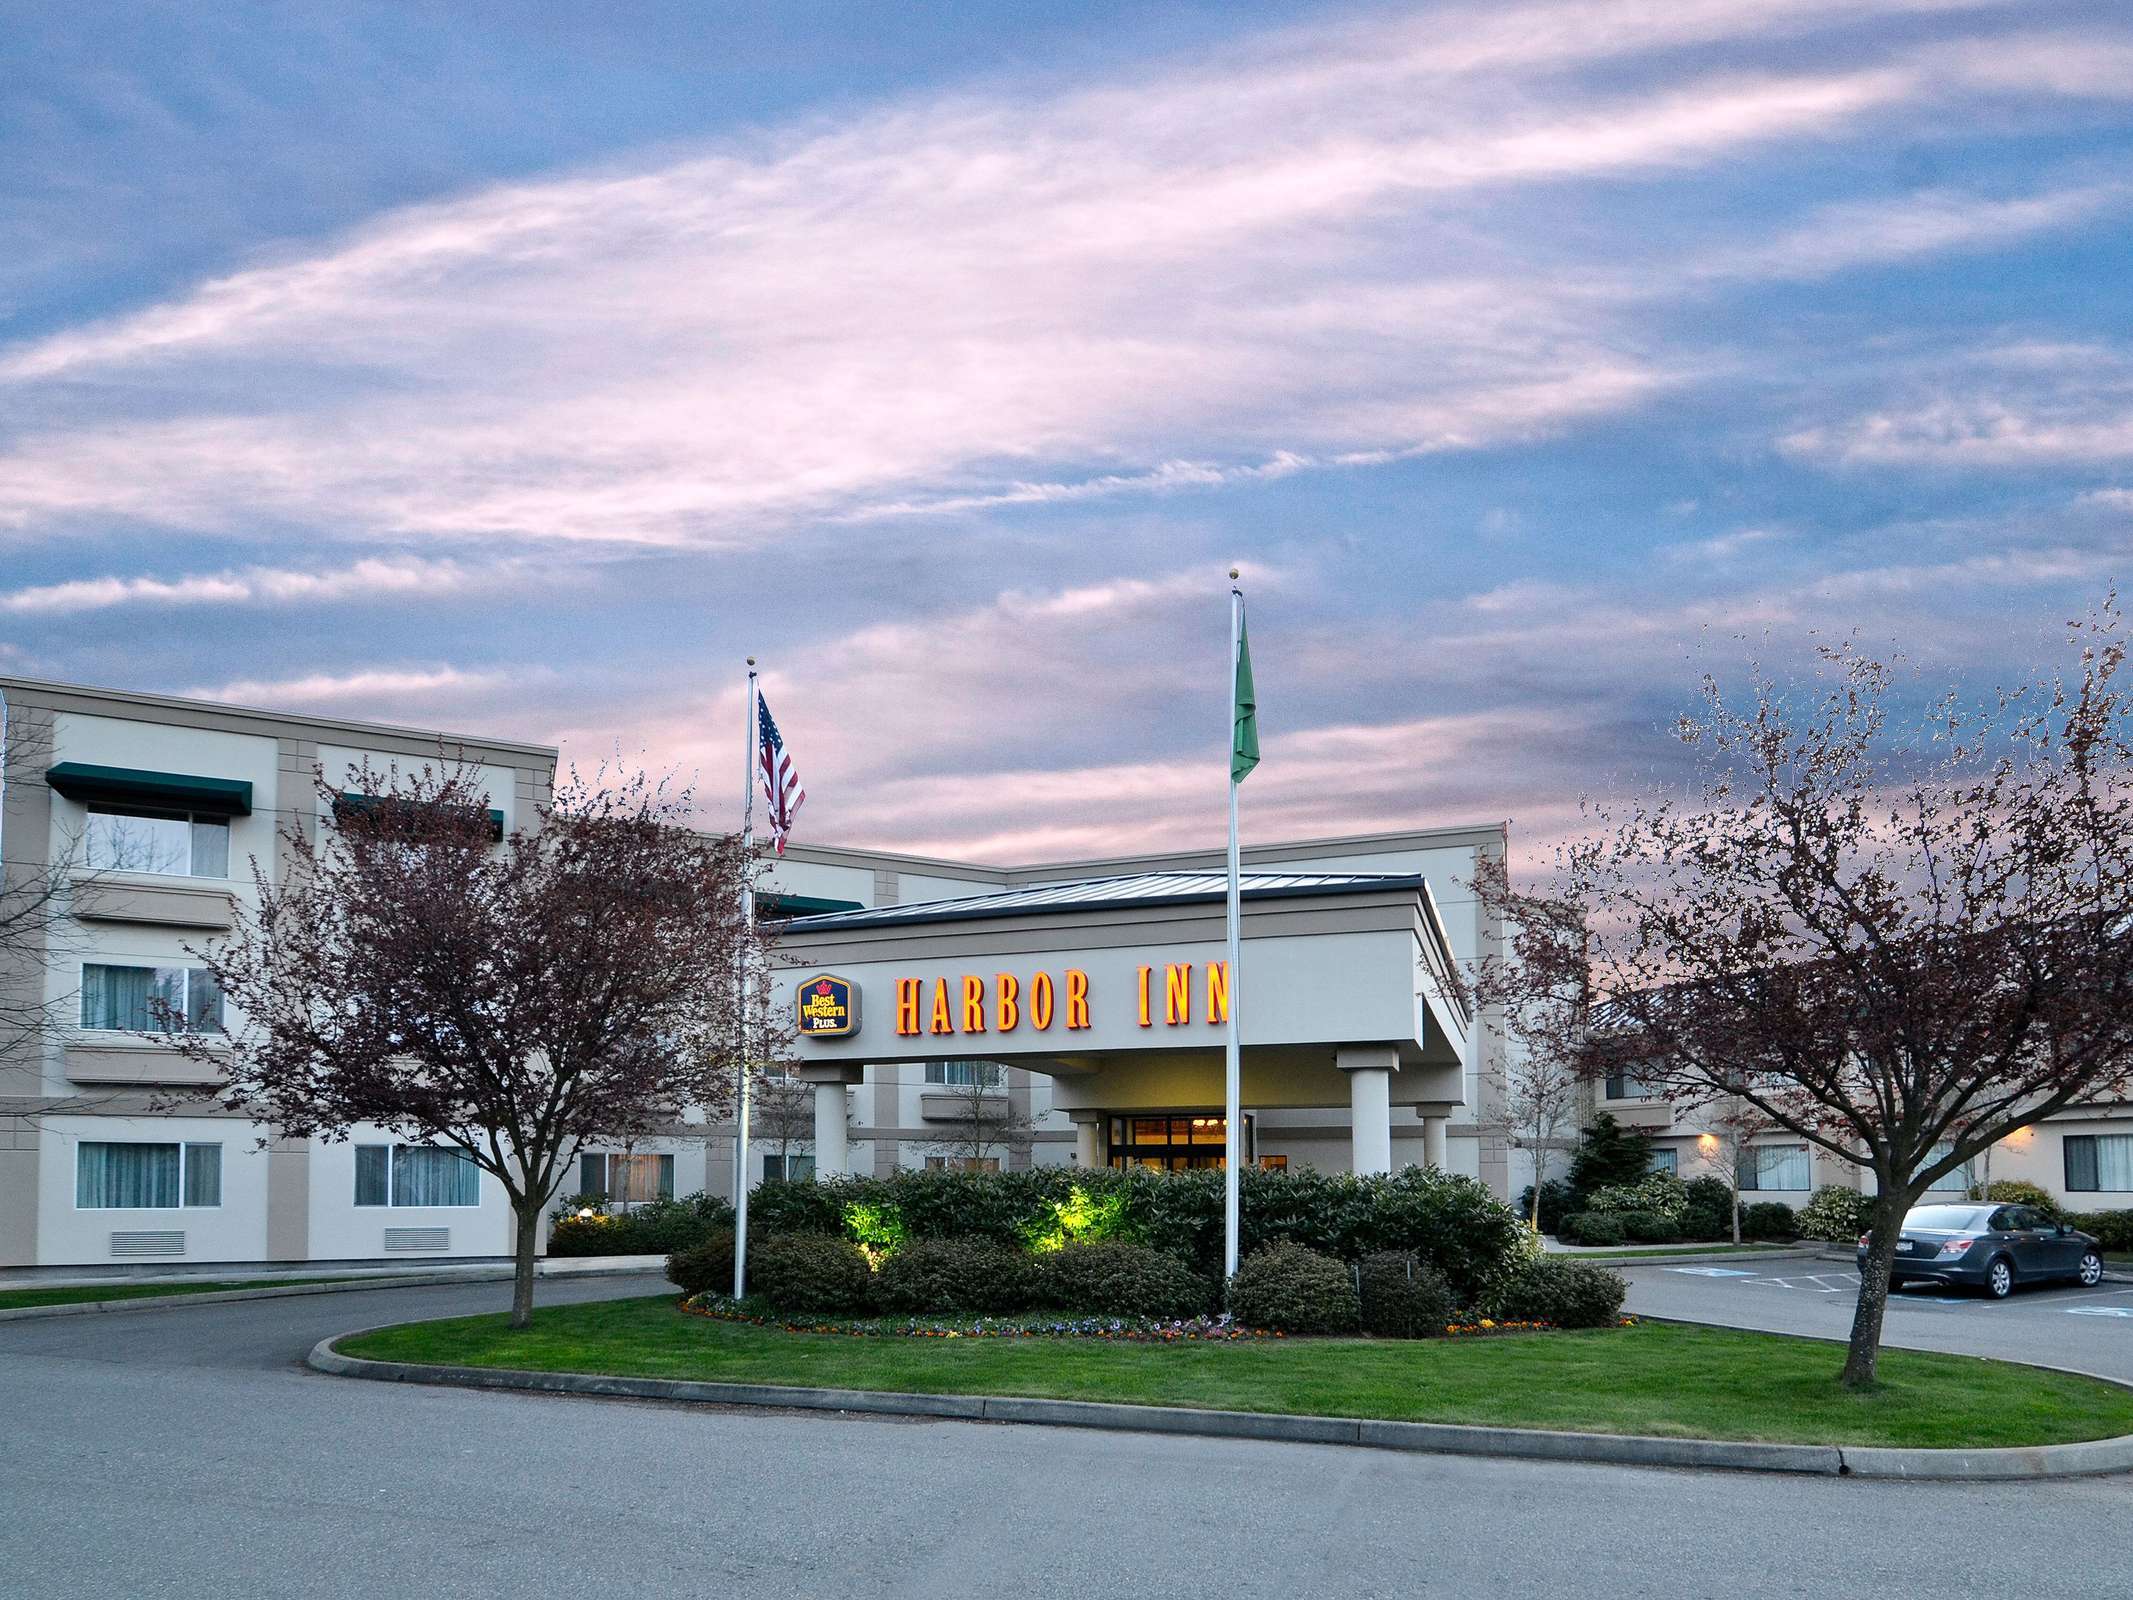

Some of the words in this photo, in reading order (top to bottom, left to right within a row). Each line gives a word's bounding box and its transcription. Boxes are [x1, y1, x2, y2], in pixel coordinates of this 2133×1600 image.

[811, 993, 836, 1007] Best
[895, 968, 1092, 1035] HARBOR
[1136, 960, 1228, 1027] INN
[803, 1004, 846, 1019] Western
